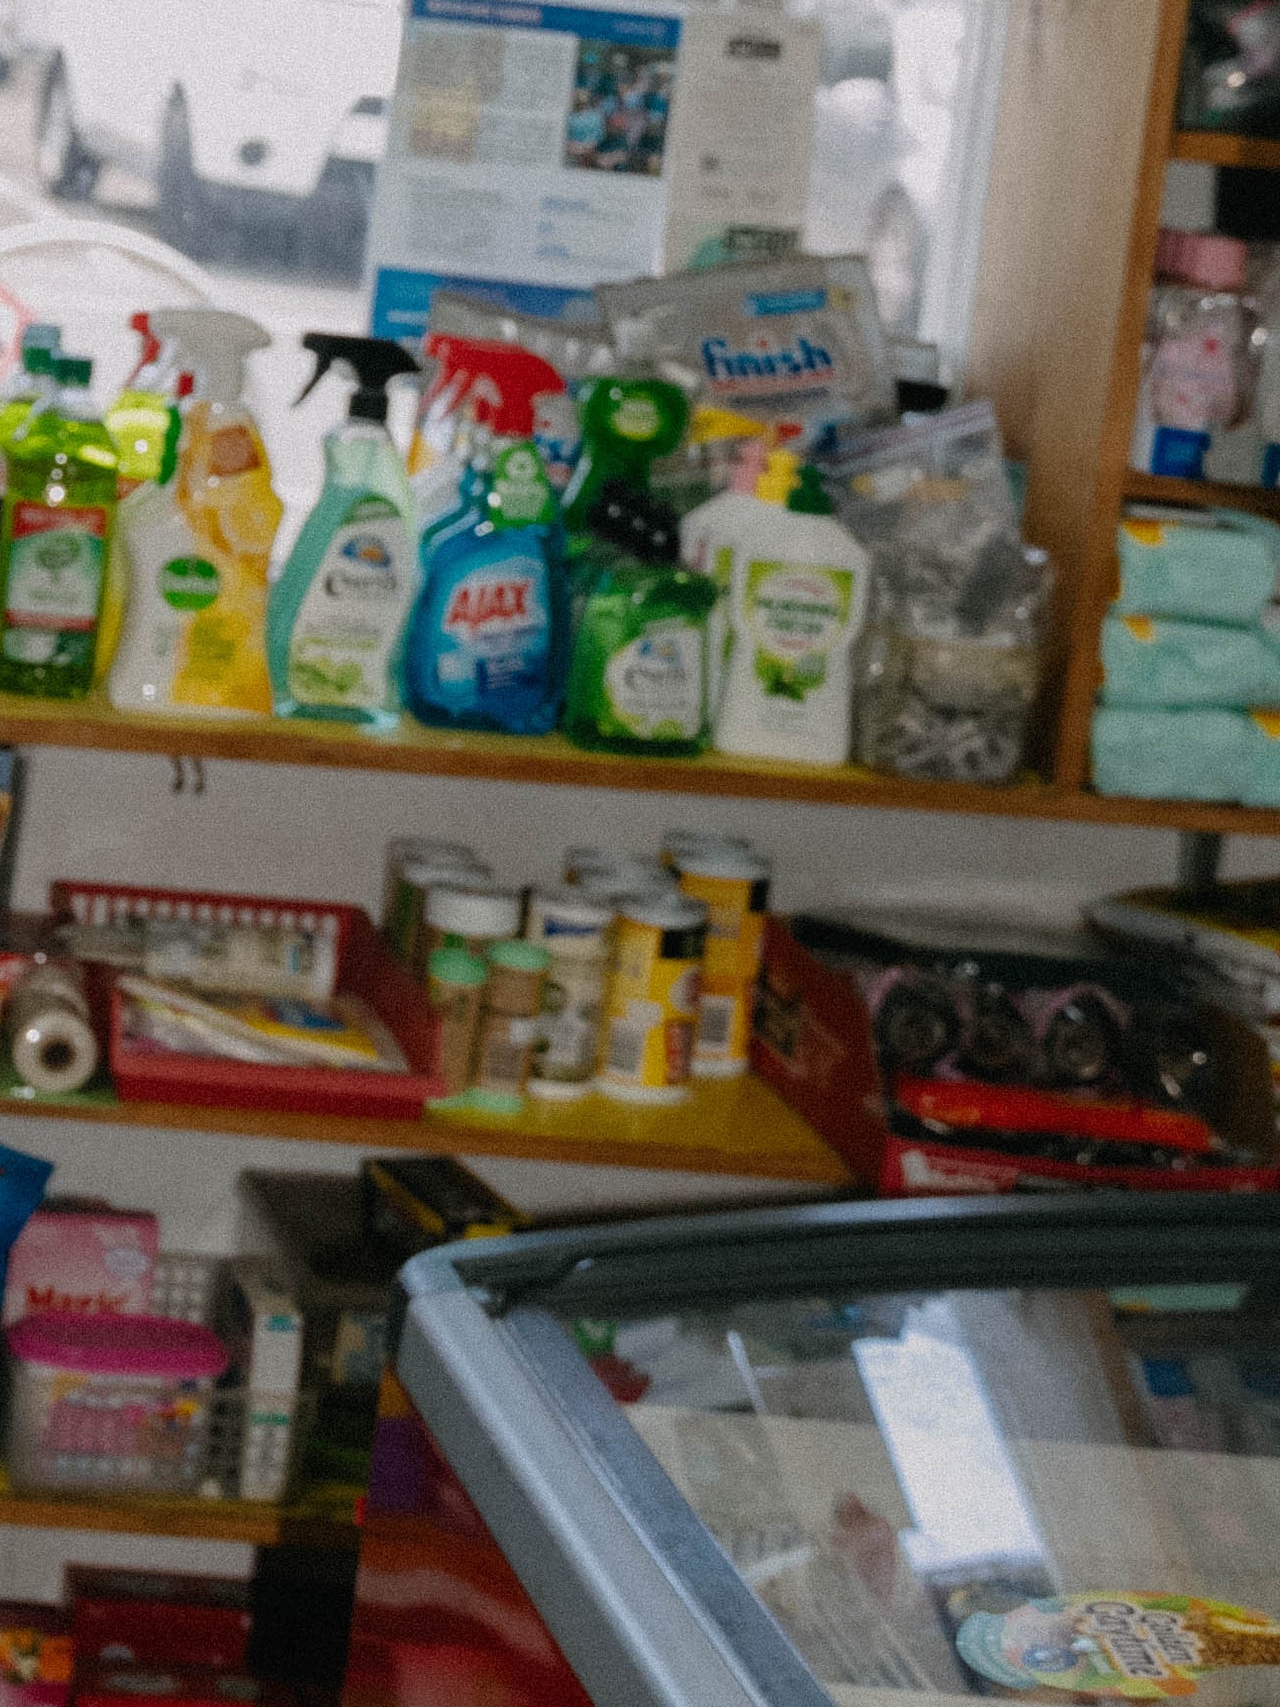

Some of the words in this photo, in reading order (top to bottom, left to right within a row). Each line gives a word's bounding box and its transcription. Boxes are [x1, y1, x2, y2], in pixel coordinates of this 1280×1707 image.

[703, 336, 831, 383] finish
[448, 582, 529, 625] AJAX
[1085, 1600, 1168, 1679] Gaytime
